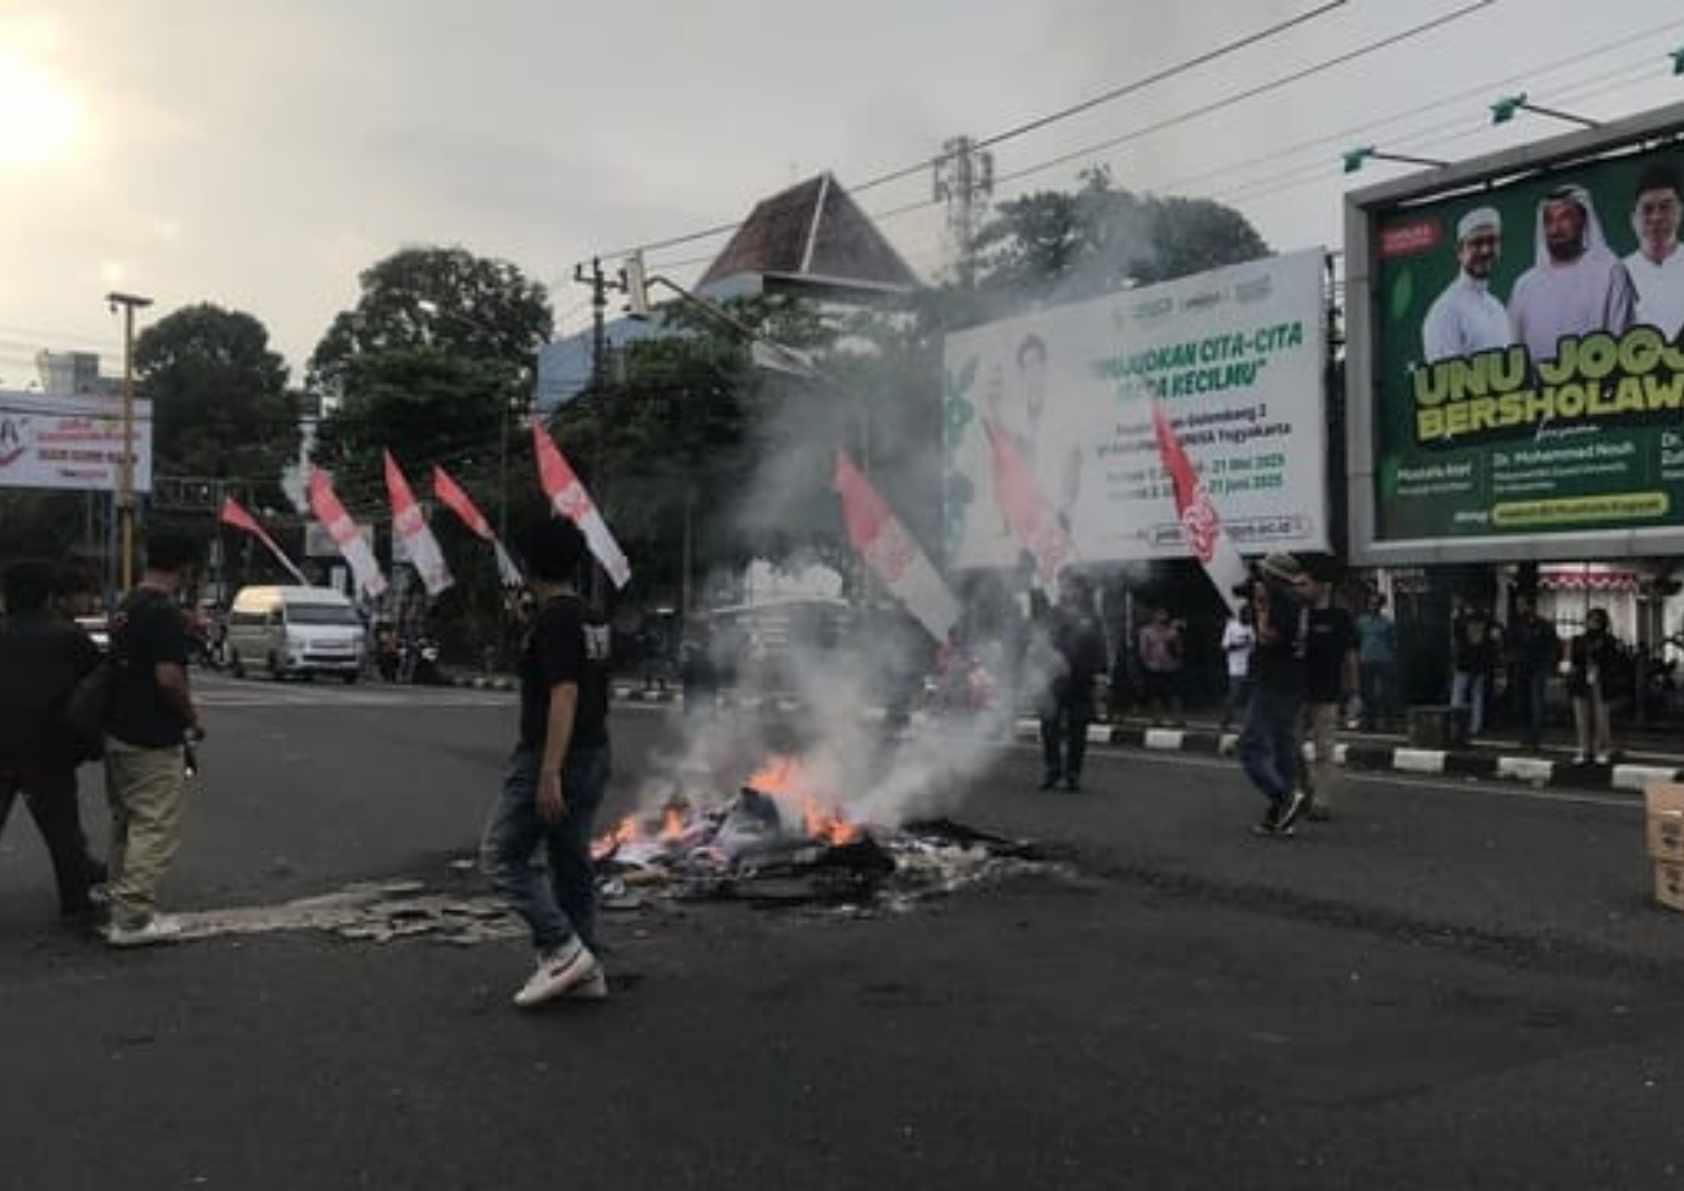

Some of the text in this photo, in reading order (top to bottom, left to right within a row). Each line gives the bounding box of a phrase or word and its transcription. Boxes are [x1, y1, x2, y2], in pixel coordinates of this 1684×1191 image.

[1202, 321, 1303, 363] CITA-CITA
[1413, 346, 1526, 404] UNU
[1417, 373, 1684, 441] BERSHOLAW
